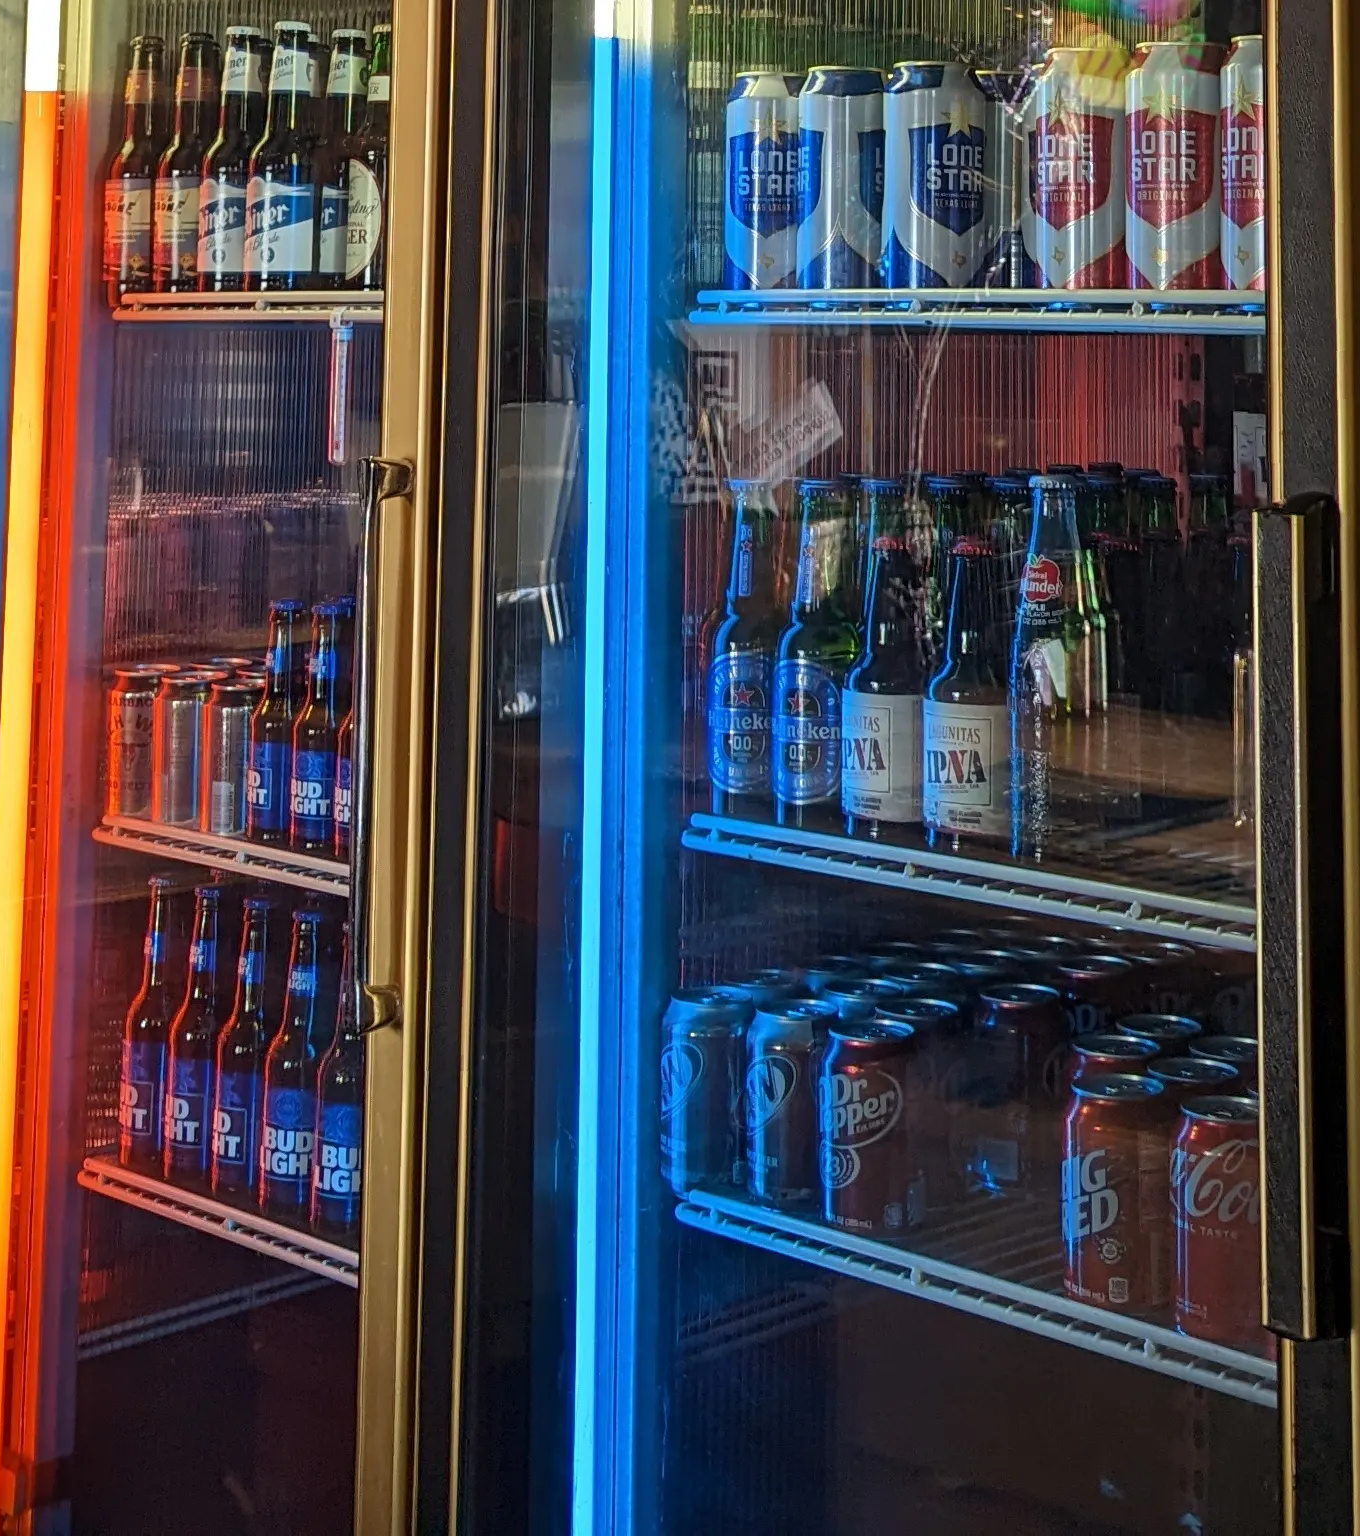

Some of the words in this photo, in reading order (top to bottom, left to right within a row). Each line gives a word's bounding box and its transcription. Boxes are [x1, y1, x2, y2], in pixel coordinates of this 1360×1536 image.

[1037, 133, 1093, 159] LONE
[1132, 130, 1197, 155] LONE
[1221, 125, 1264, 154] LON
[738, 150, 799, 173] LONE
[927, 143, 983, 167] LONE
[926, 167, 984, 193] STAR
[1037, 157, 1096, 185] STAR
[1132, 157, 1197, 182] STAR
[738, 173, 799, 195] STAR
[708, 710, 772, 732] Heineke
[264, 1125, 314, 1153] BUD
[322, 1145, 360, 1168] BU
